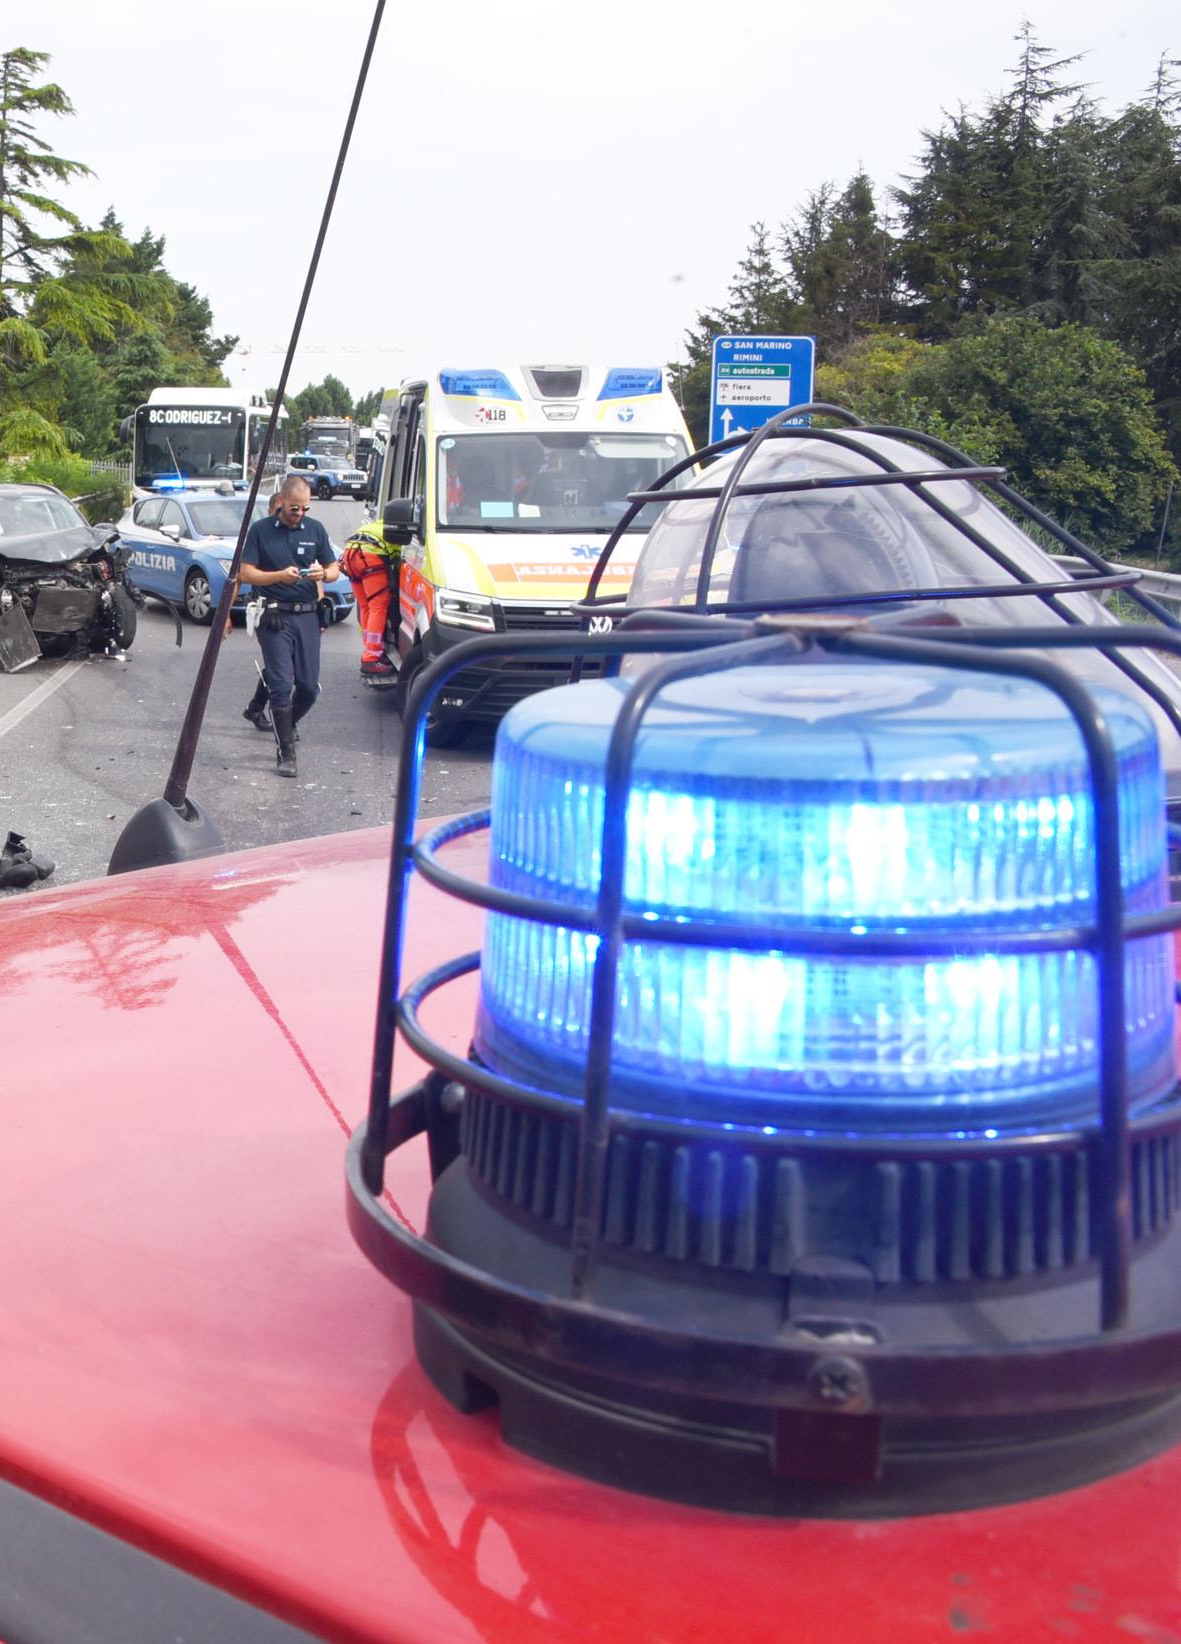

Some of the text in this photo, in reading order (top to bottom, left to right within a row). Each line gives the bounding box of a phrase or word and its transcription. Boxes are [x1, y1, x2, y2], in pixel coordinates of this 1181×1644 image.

[755, 342, 792, 350] MARINO
[733, 354, 763, 362] RIMINI
[732, 367, 775, 375] autostrada
[731, 394, 771, 402] aeroporto
[488, 409, 506, 421] 118
